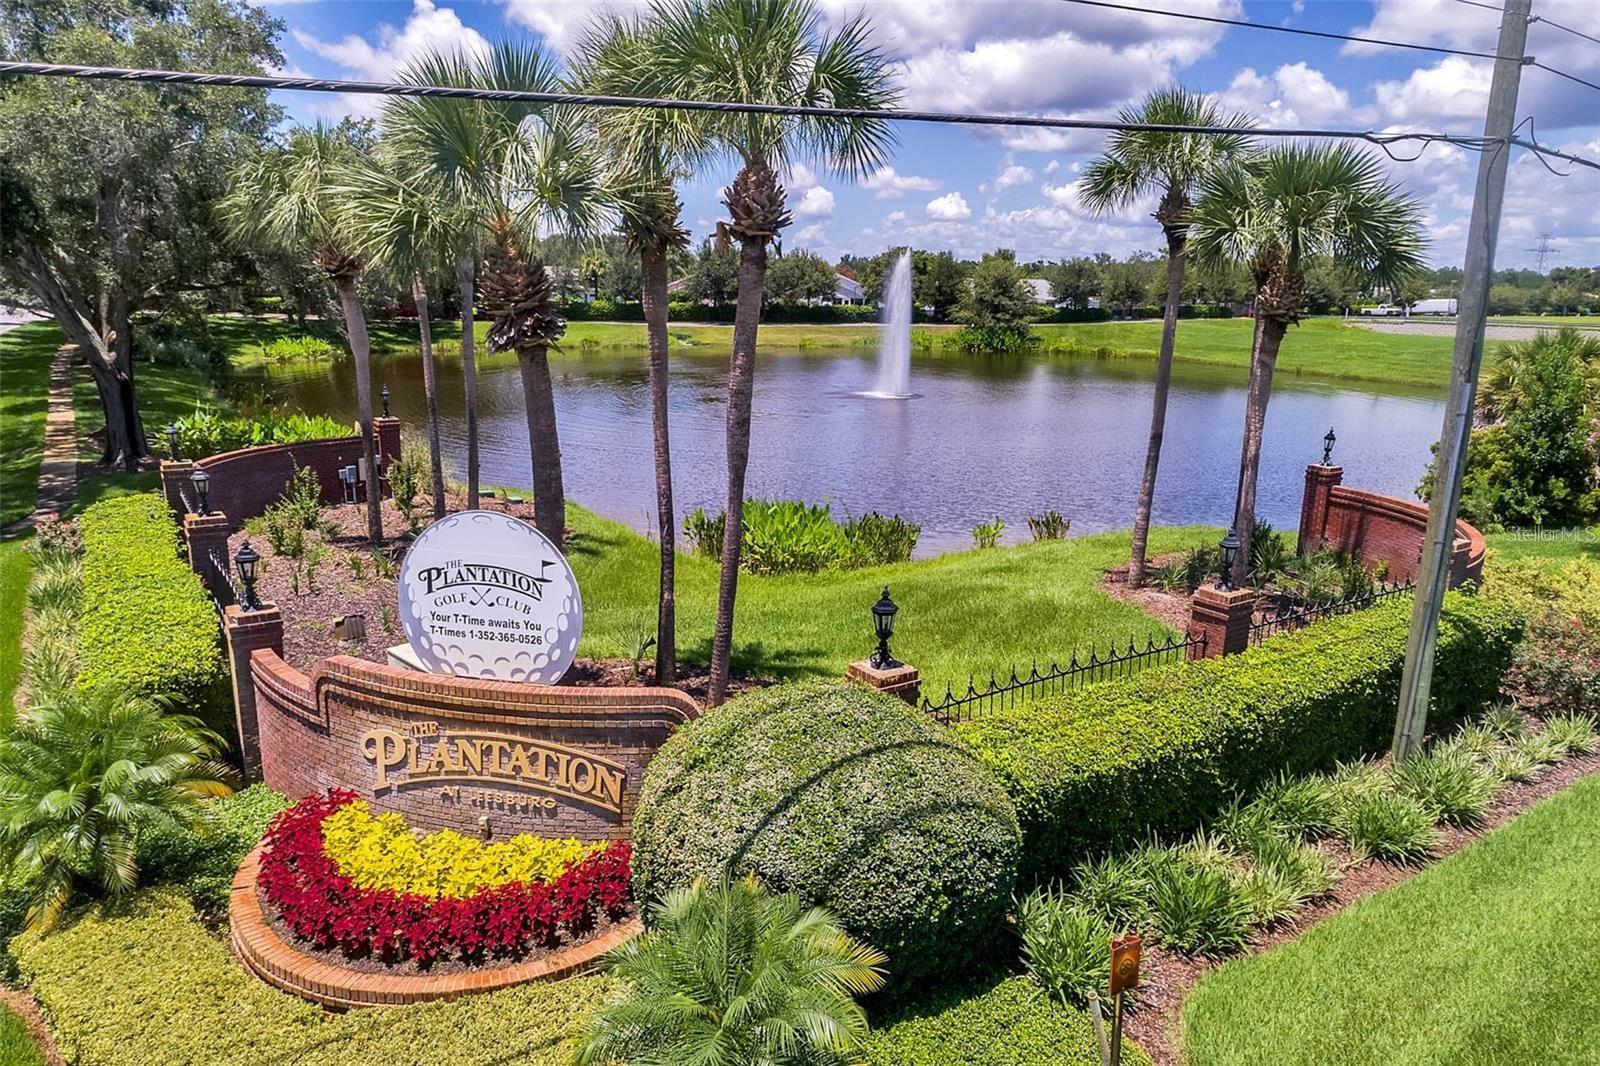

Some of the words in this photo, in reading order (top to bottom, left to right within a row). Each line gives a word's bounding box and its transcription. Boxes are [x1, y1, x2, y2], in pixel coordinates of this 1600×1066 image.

[445, 559, 463, 570] THE
[418, 567, 543, 599] PLANTATION
[434, 592, 468, 608] GOLF
[496, 595, 532, 615] CLUB
[430, 611, 451, 623] Your
[453, 613, 485, 627] T-Time
[488, 618, 520, 630] awaits
[523, 620, 542, 632] You
[430, 625, 466, 639] T-Times
[469, 630, 543, 646] 1-352-365-0526
[411, 721, 439, 737] THE
[360, 728, 625, 804] PLANTATION
[440, 785, 460, 797] AT
